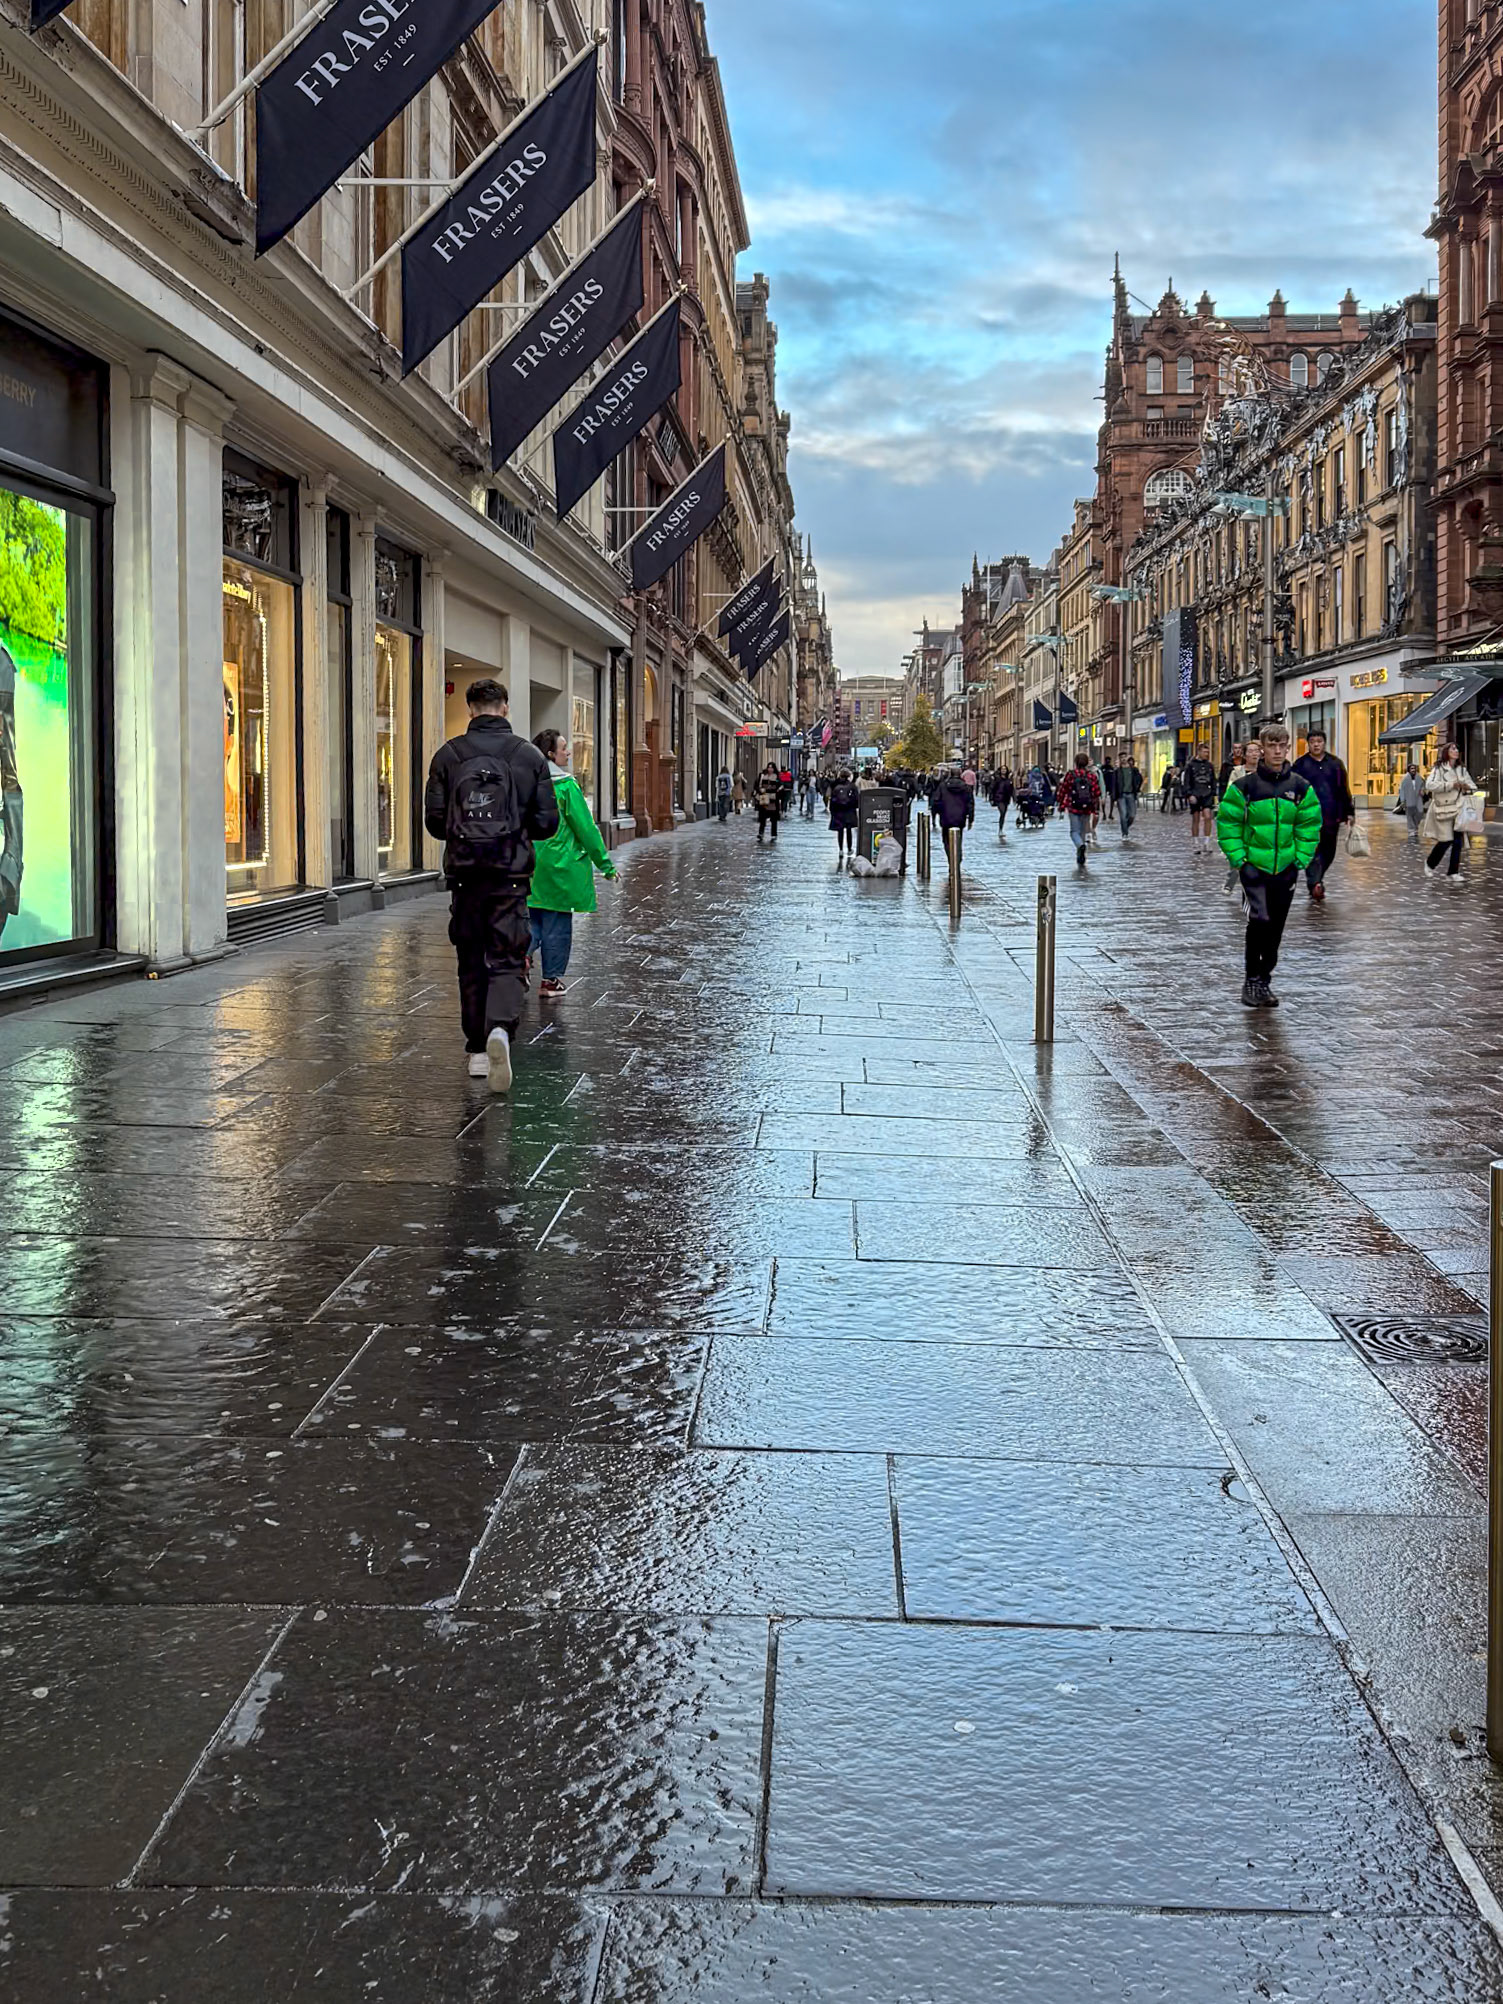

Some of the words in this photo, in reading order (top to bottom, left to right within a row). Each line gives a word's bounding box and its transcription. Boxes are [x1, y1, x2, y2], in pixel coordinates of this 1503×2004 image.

[294, 0, 414, 106] FRASE
[373, 49, 394, 72] EST
[394, 24, 417, 49] 1849
[431, 142, 547, 263] FRASERS
[490, 222, 506, 239] EST
[506, 203, 525, 222] 1849
[511, 278, 604, 379] FRASERS
[558, 344, 572, 357] EST
[571, 327, 586, 344] 1849
[0, 374, 37, 408] ERRY
[572, 360, 648, 445] FRASERS
[646, 491, 701, 551] FRASERS
[726, 584, 761, 620] FRASERS
[736, 601, 769, 633] FRASERS
